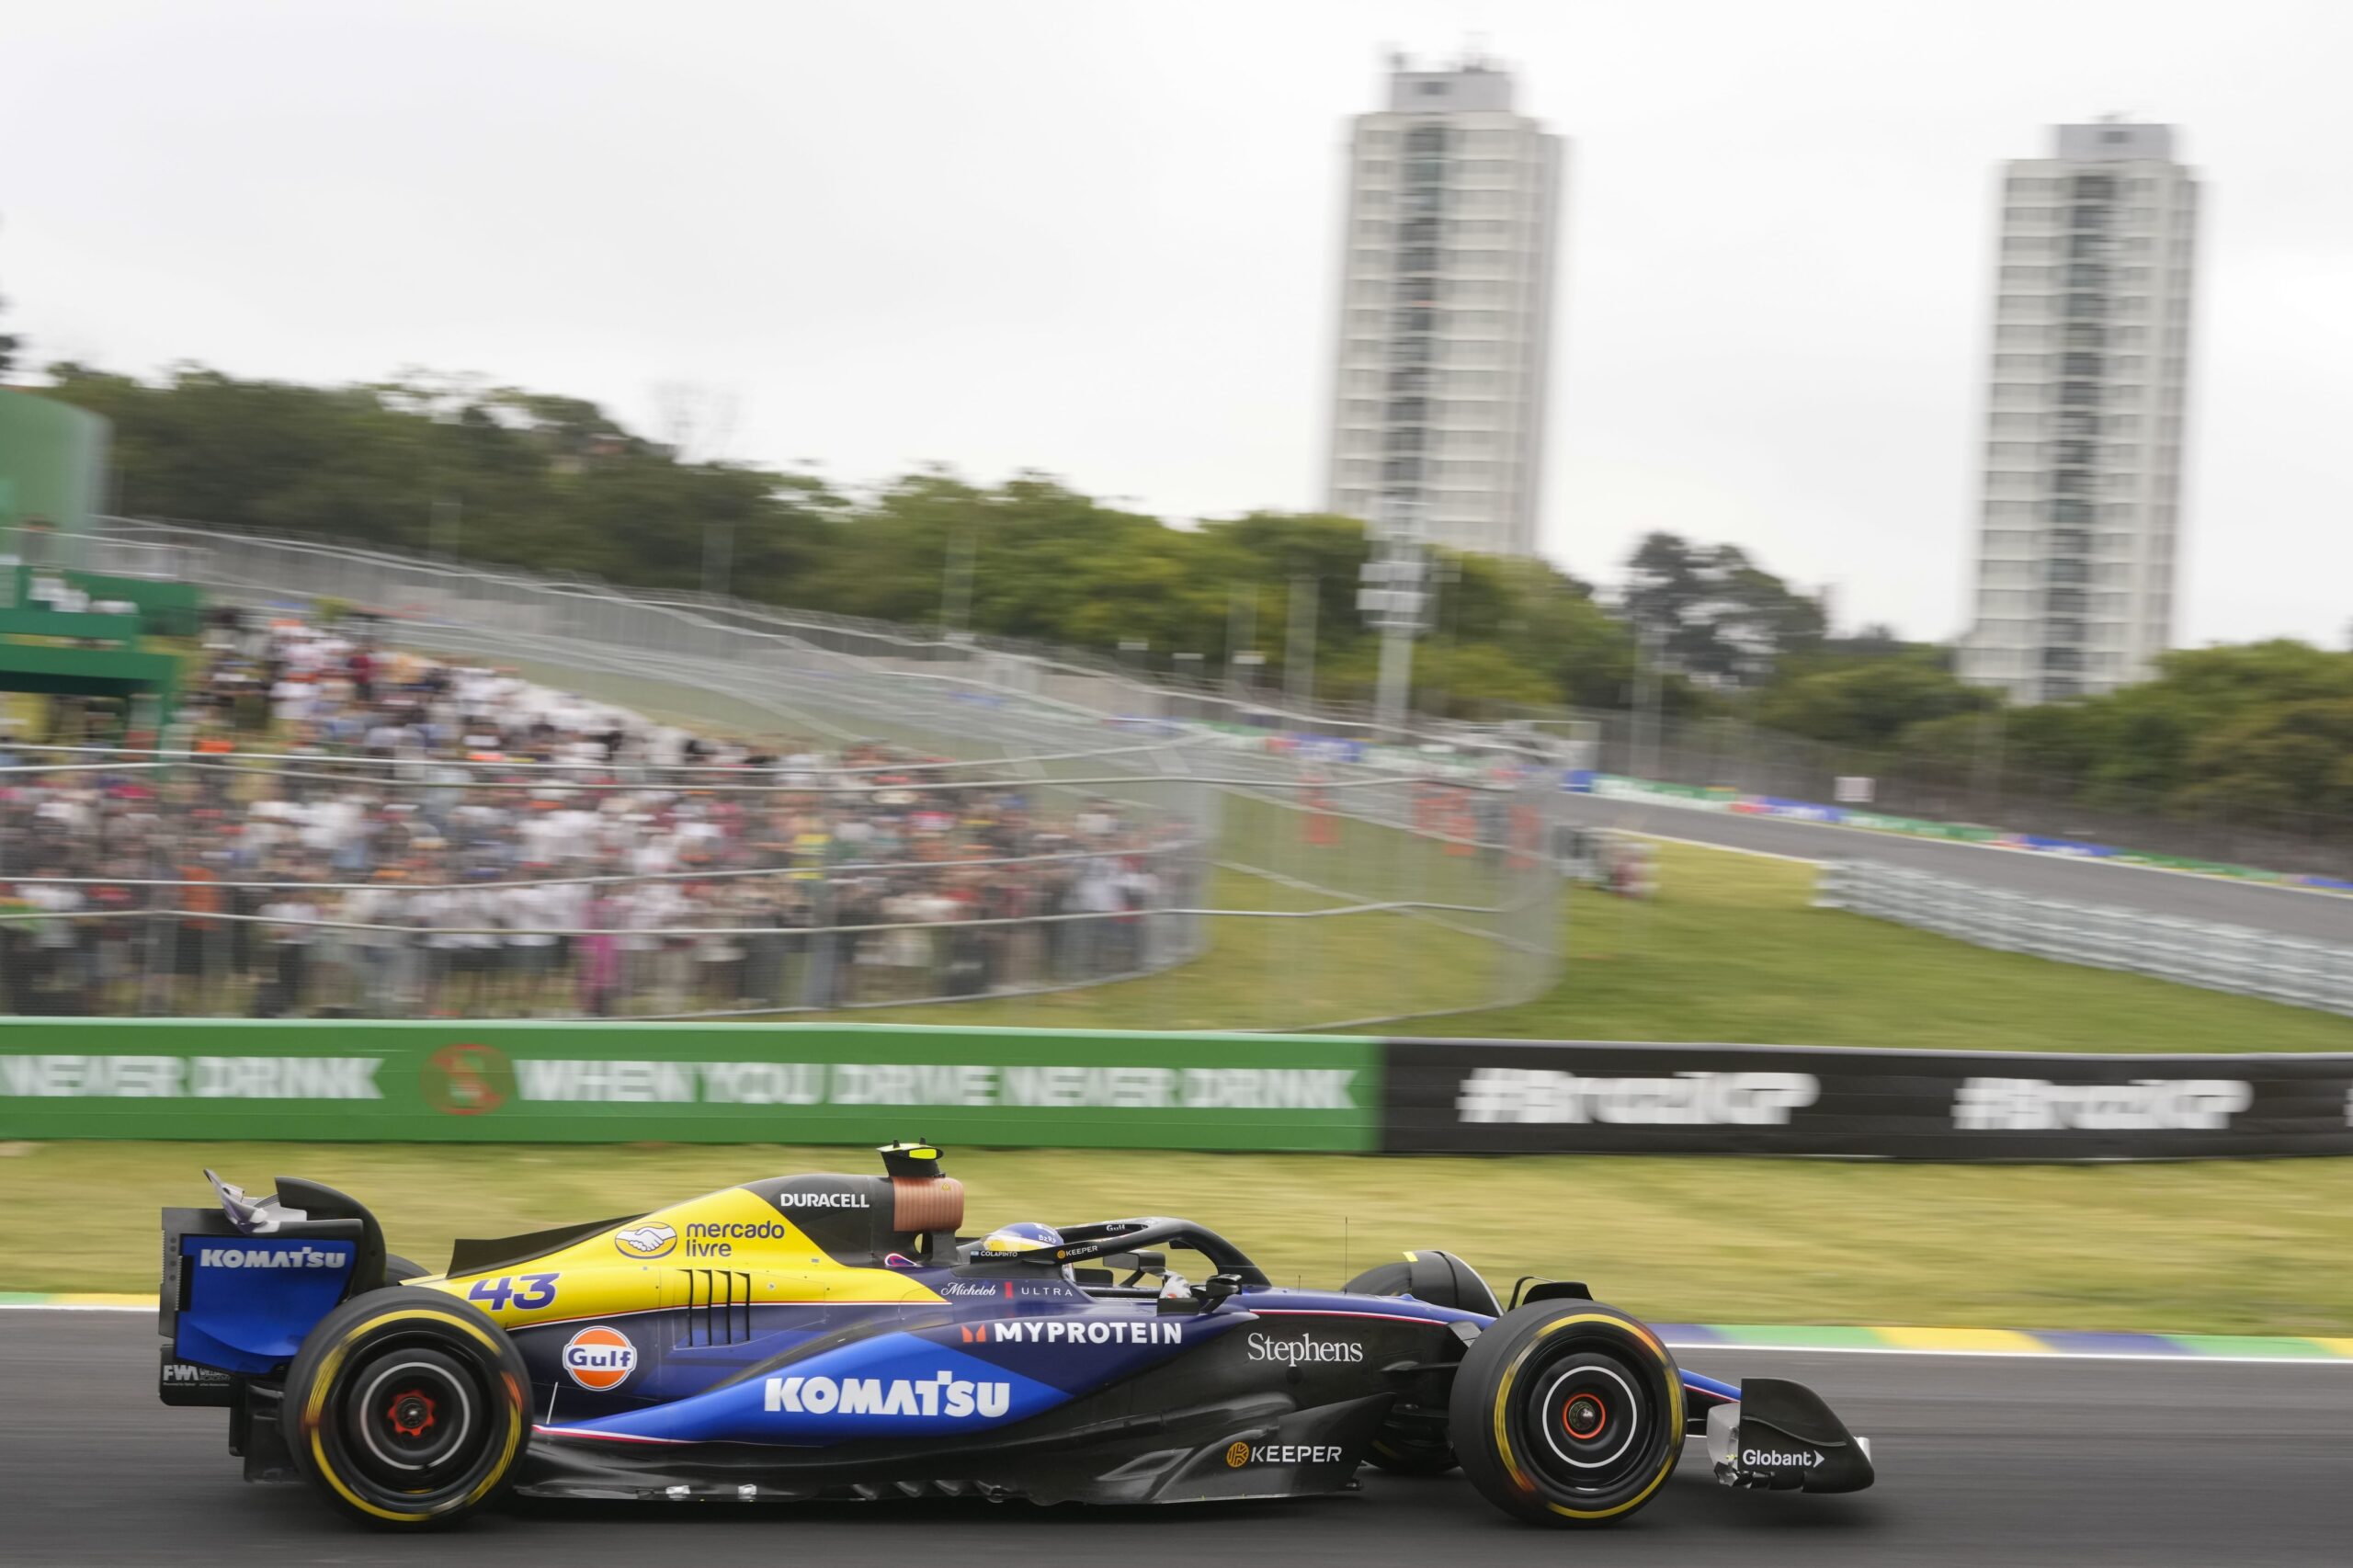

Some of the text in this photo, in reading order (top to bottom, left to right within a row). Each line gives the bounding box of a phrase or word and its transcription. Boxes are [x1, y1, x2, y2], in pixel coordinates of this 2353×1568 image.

[188, 1056, 386, 1098] DRINK
[512, 1060, 1358, 1108] WHEN YOU DRIVE NEVER DRINK
[780, 1193, 870, 1209] DURACELL
[686, 1221, 785, 1239] mercado
[199, 1246, 346, 1268] KOMATSU
[686, 1240, 732, 1257] livre
[1065, 1245, 1097, 1256] KEEPER
[468, 1272, 561, 1312] 43
[941, 1282, 1073, 1297] Michelob ULTRA
[994, 1322, 1182, 1345] MYPROTEIN
[567, 1347, 632, 1368] Gulf
[1247, 1333, 1363, 1367] Stephens
[764, 1370, 1010, 1418] KOMATSU
[1250, 1446, 1343, 1462] KEEPER
[1743, 1449, 1813, 1466] Globant
